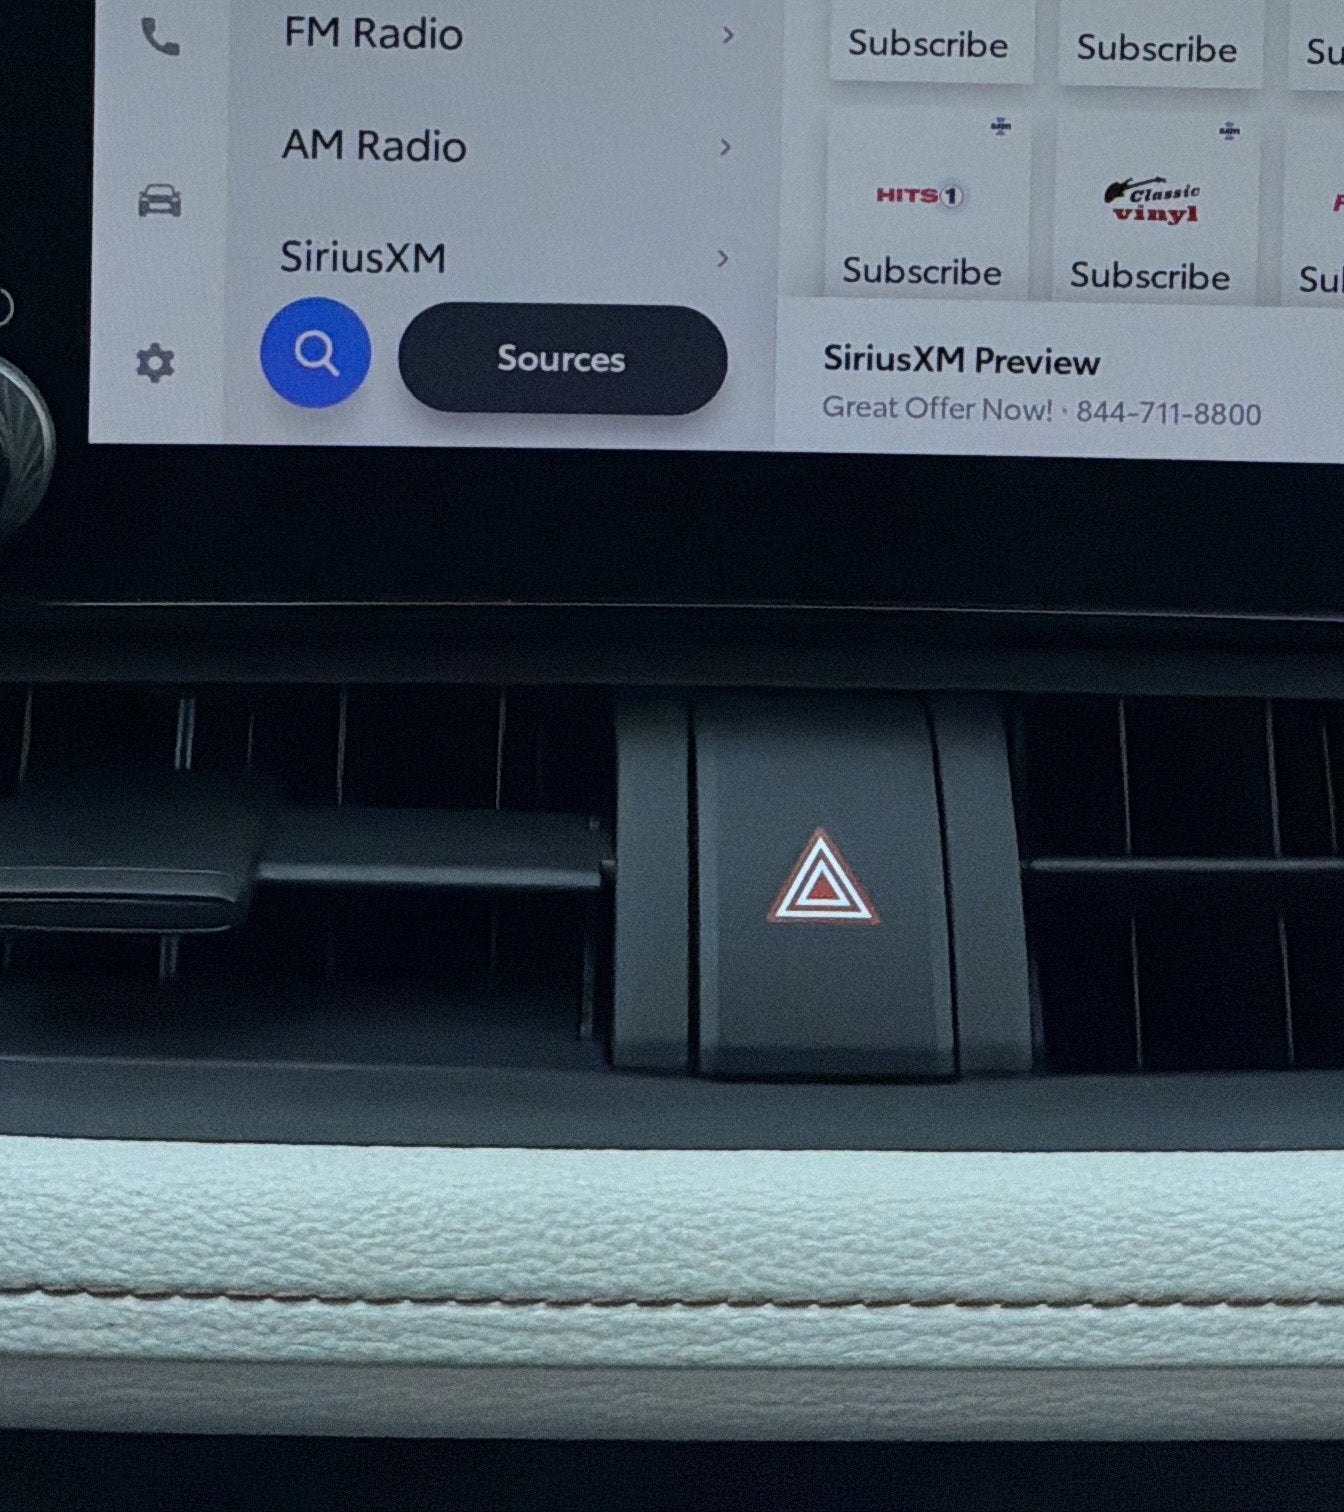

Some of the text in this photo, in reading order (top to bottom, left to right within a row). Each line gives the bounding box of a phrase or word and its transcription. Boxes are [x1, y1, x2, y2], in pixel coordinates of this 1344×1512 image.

[286, 15, 463, 51] FM Radio
[849, 28, 1008, 59] Subscribe
[1077, 32, 1237, 63] Subscribe
[281, 128, 467, 163] AM Radio
[876, 187, 939, 204] HITS
[1126, 182, 1200, 203] Classic
[1112, 204, 1198, 226] vinyl
[280, 239, 445, 274] SiriusXM
[843, 255, 1002, 286] Subscribe
[1070, 260, 1231, 291] Subscribe
[497, 343, 626, 373] Sources
[824, 343, 1101, 376] SiriusXM Preview
[822, 394, 1262, 427] Great Offer Now! 844-711-8800
